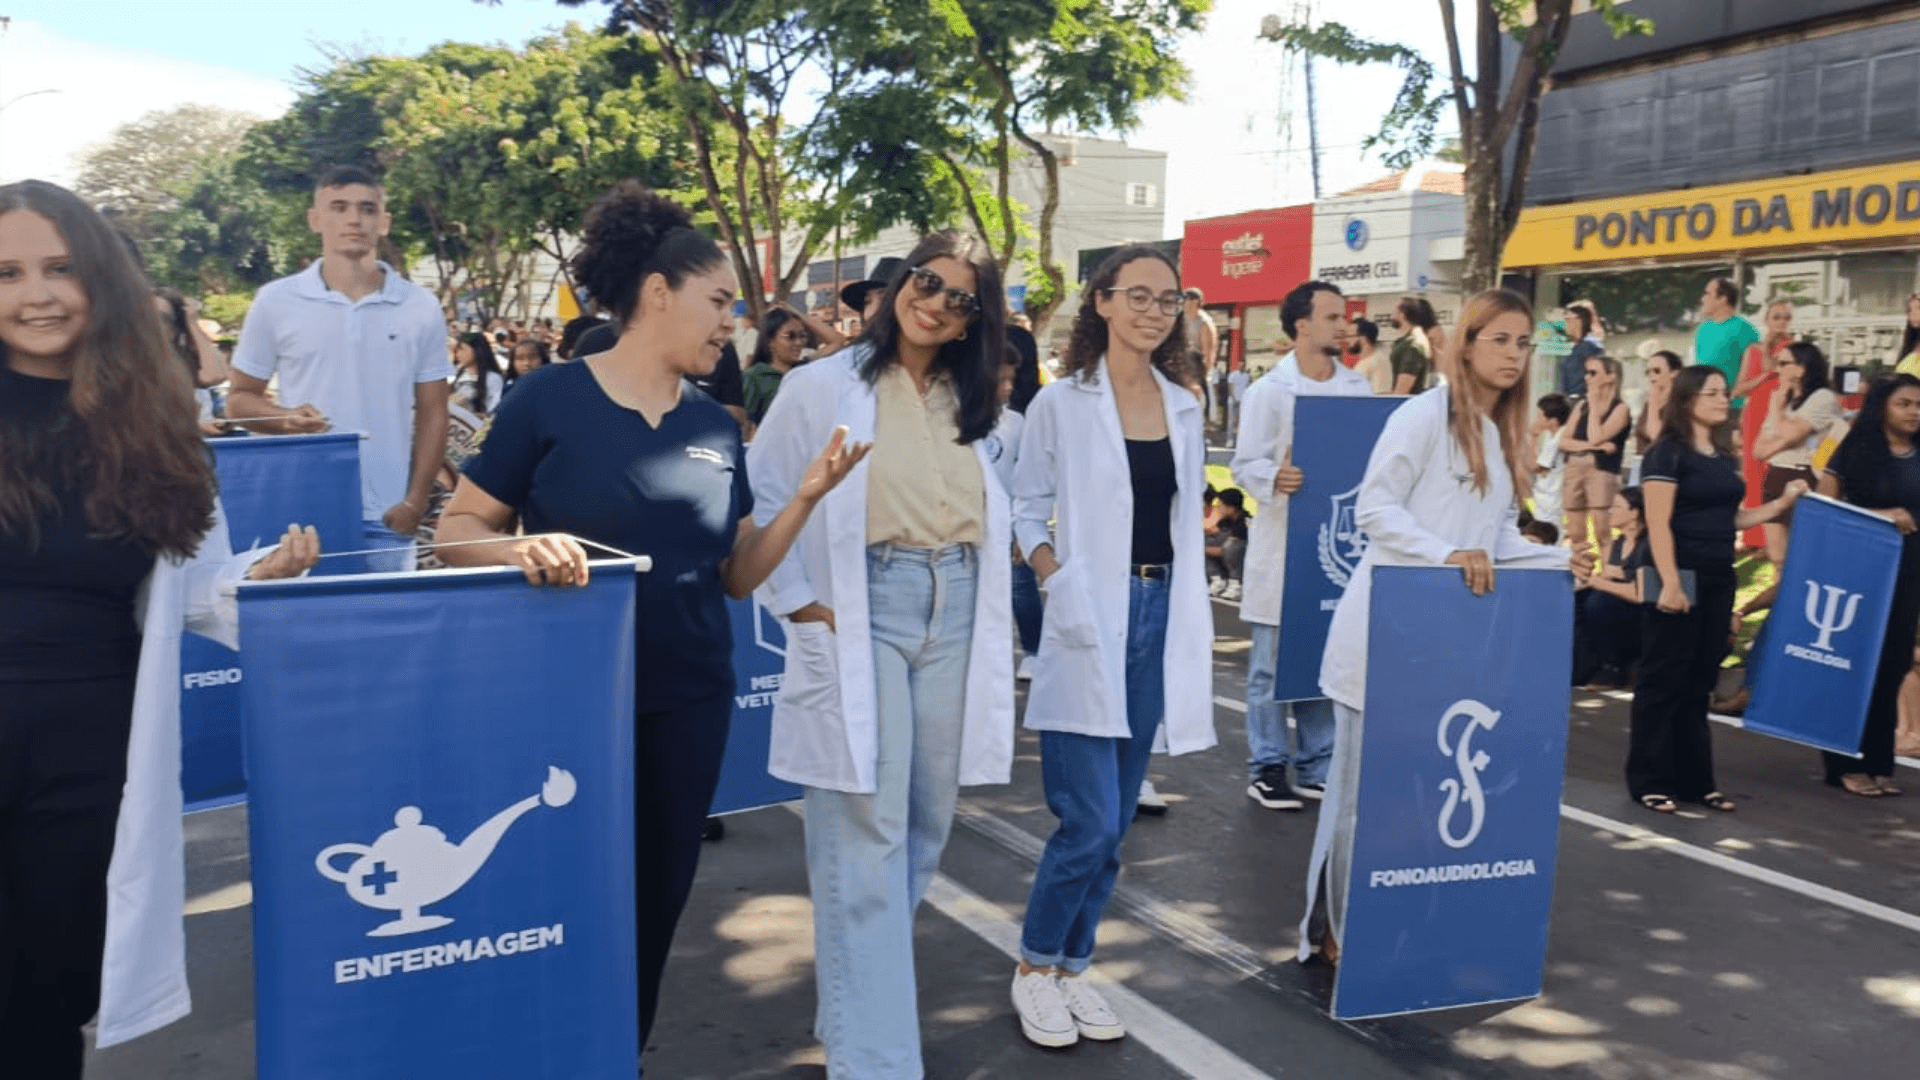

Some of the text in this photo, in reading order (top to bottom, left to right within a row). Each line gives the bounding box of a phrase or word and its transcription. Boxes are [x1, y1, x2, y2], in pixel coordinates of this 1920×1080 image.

[1573, 179, 1920, 250] PONTO DA MOD
[1784, 643, 1852, 671] PSICOLOGIA
[1369, 858, 1537, 888] FONOAUDIOLOGIA
[335, 923, 564, 983] ENFERMAGEM
